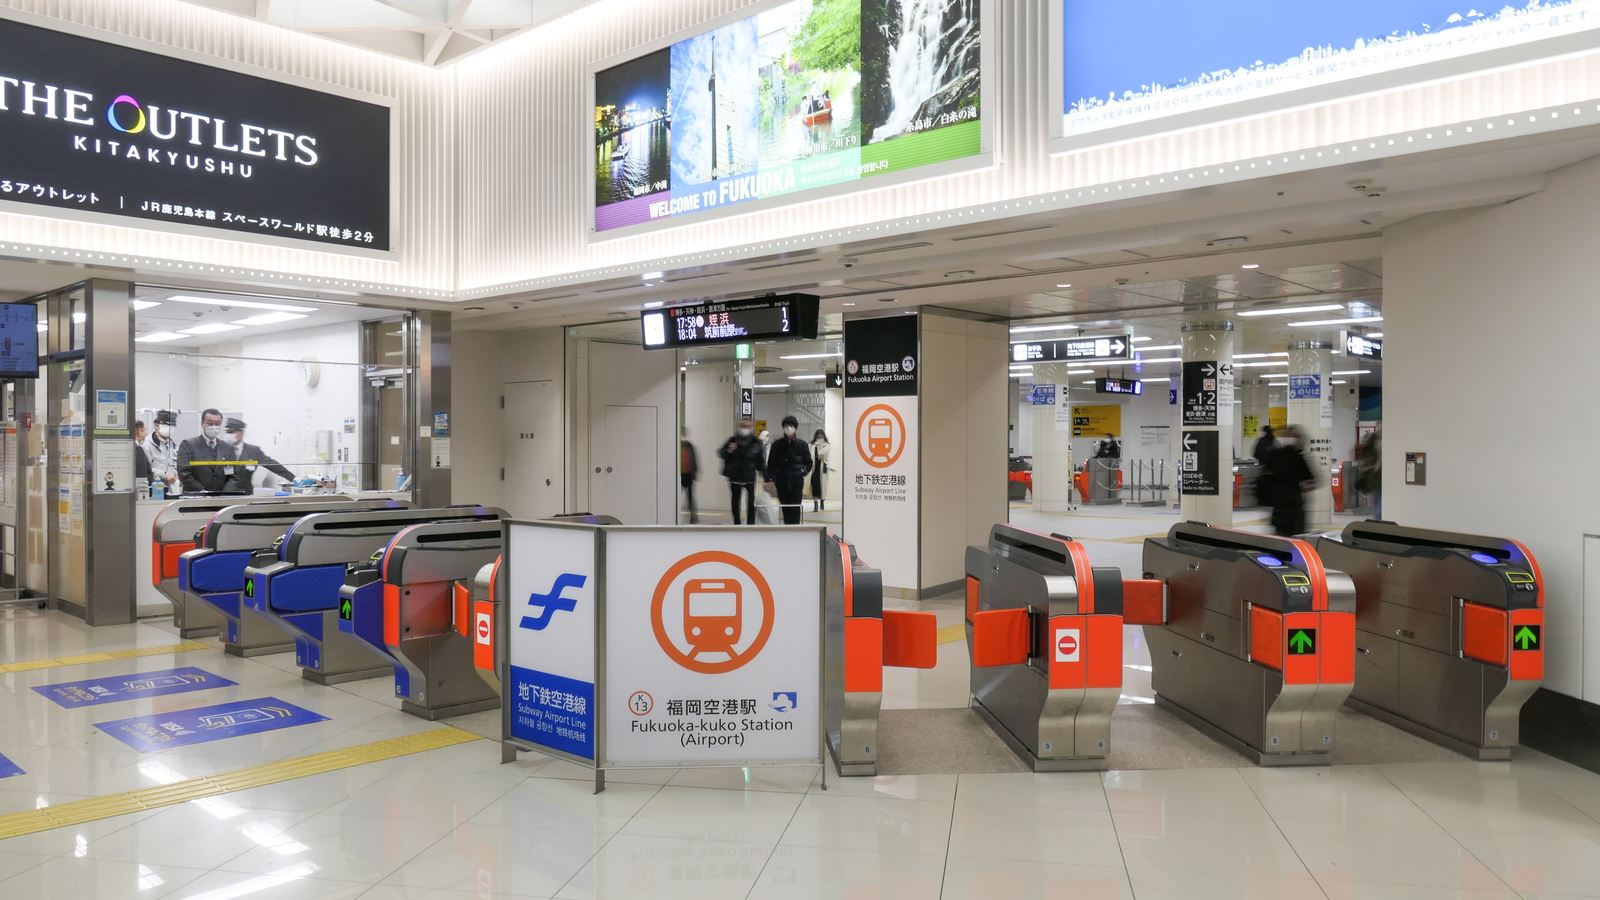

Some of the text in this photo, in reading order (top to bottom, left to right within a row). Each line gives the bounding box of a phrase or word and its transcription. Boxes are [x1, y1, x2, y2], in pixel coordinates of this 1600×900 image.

[0, 75, 319, 166] THE OUTLETS
[73, 135, 254, 179] KITAKYUSHU
[649, 193, 700, 219] WELCOME
[702, 189, 717, 208] TO
[719, 167, 796, 204] FUKUOKA
[141, 200, 374, 243] JR鹿児島本線 スペースワールド駅徒歩2分
[677, 316, 696, 330] 17:58
[781, 306, 787, 320] 1
[678, 328, 698, 341] 18:04
[782, 319, 790, 332] 2
[861, 363, 900, 374] 福岡空港駅
[872, 374, 893, 383] Airport
[893, 373, 914, 381] Station
[855, 474, 907, 486] 地下鉄空港線
[518, 681, 587, 715] 地下鉄空港線
[634, 701, 648, 712] 13
[666, 699, 757, 716] 福岡空港駅
[517, 702, 587, 730] Subway Airport Line
[631, 718, 793, 733] Fukuoka-kuko Station
[680, 732, 745, 748] (Airport)
